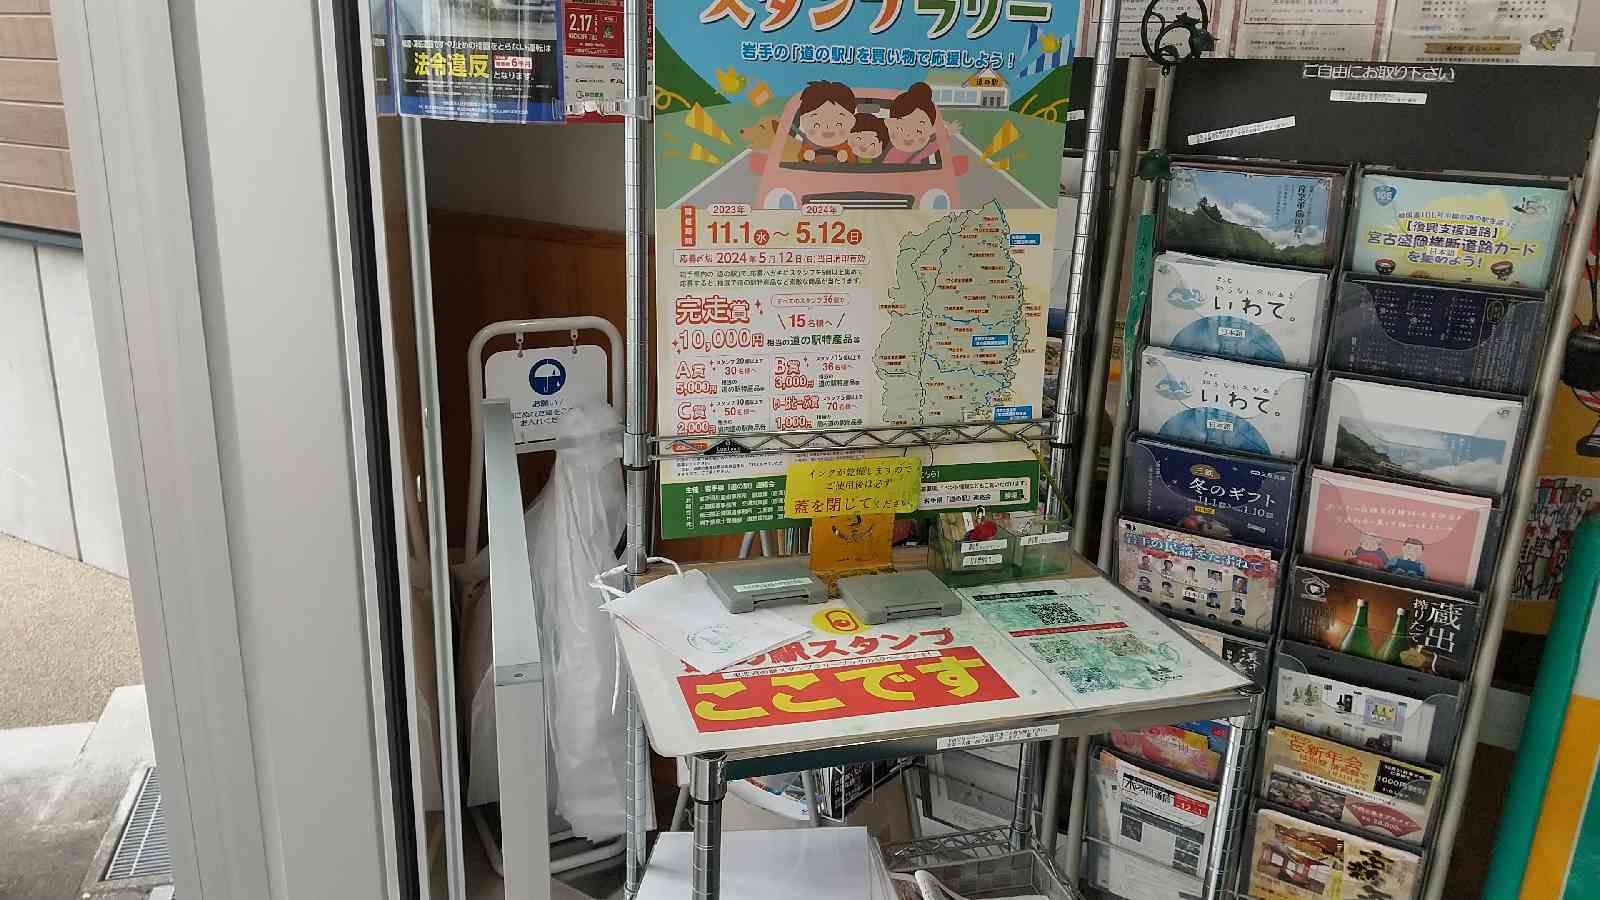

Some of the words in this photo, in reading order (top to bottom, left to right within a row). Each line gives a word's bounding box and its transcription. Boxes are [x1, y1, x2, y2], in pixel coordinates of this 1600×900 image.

[414, 51, 490, 79] 法令違反
[1302, 62, 1456, 82] ご自由にお取り下さい
[713, 205, 746, 214] 2023年
[806, 205, 838, 214] 2024年
[675, 294, 751, 325] 完走賞
[1213, 296, 1296, 322] いわて。
[678, 327, 765, 352] 10,000円
[675, 380, 718, 396] 5,000円
[1201, 388, 1281, 418] いわて。
[826, 479, 895, 491] ご使用後は必ず
[1187, 476, 1277, 509] 冬のギフト
[694, 656, 986, 722] ここです
